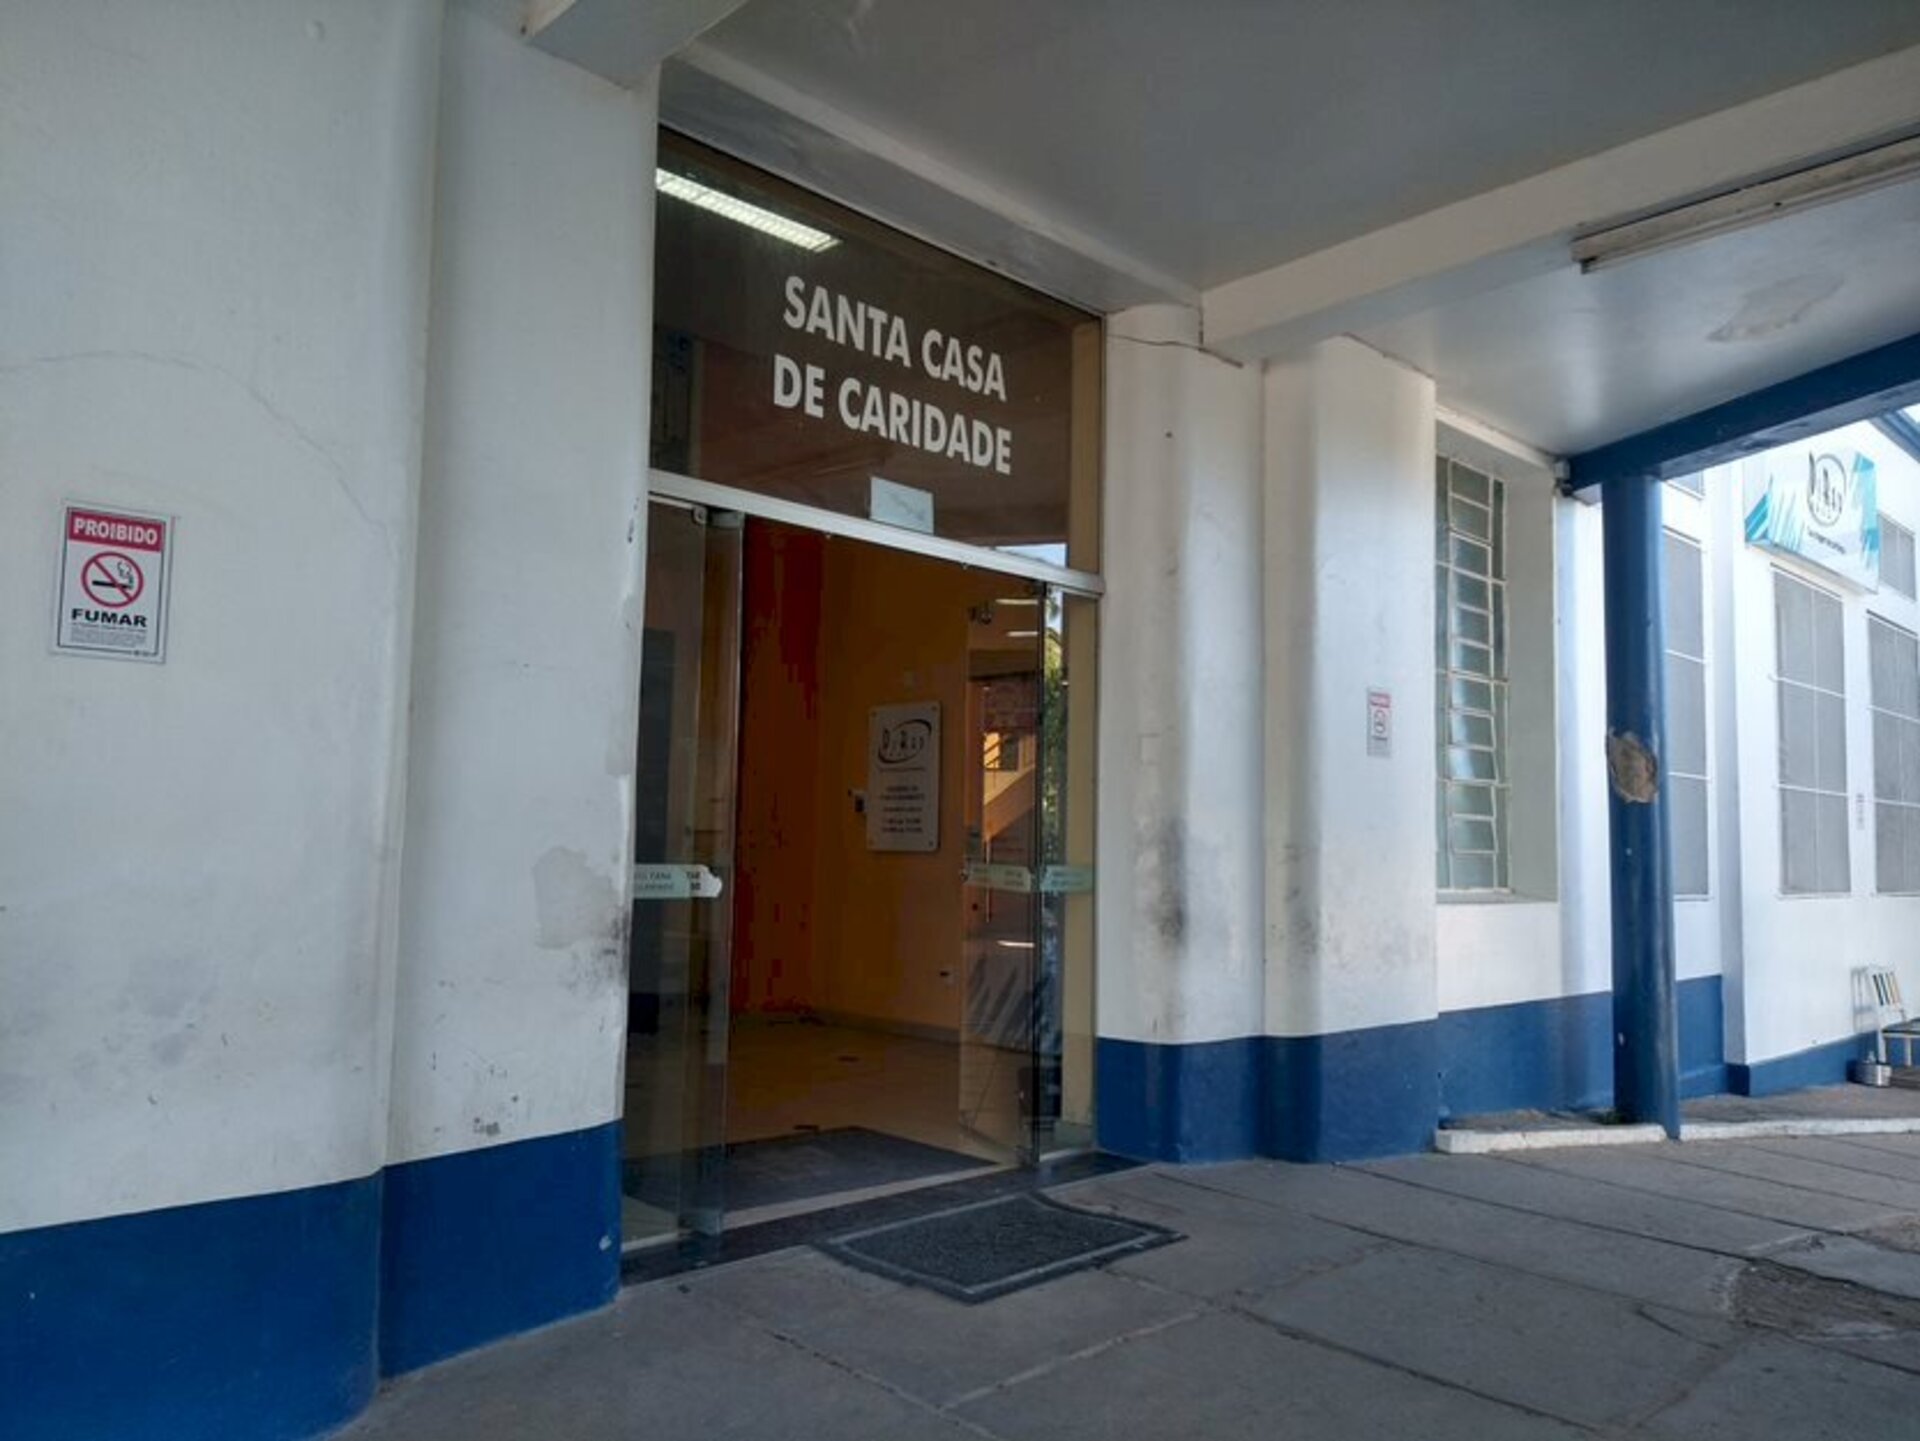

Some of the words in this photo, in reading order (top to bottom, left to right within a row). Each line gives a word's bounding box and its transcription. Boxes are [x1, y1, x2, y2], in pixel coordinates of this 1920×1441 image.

[783, 276, 911, 367] SANTA
[922, 329, 1006, 402] CASA
[774, 354, 825, 418] DE
[838, 377, 1012, 475] CARIDADE
[73, 517, 158, 545] PROIBIDO
[72, 608, 147, 627] FUMAR
